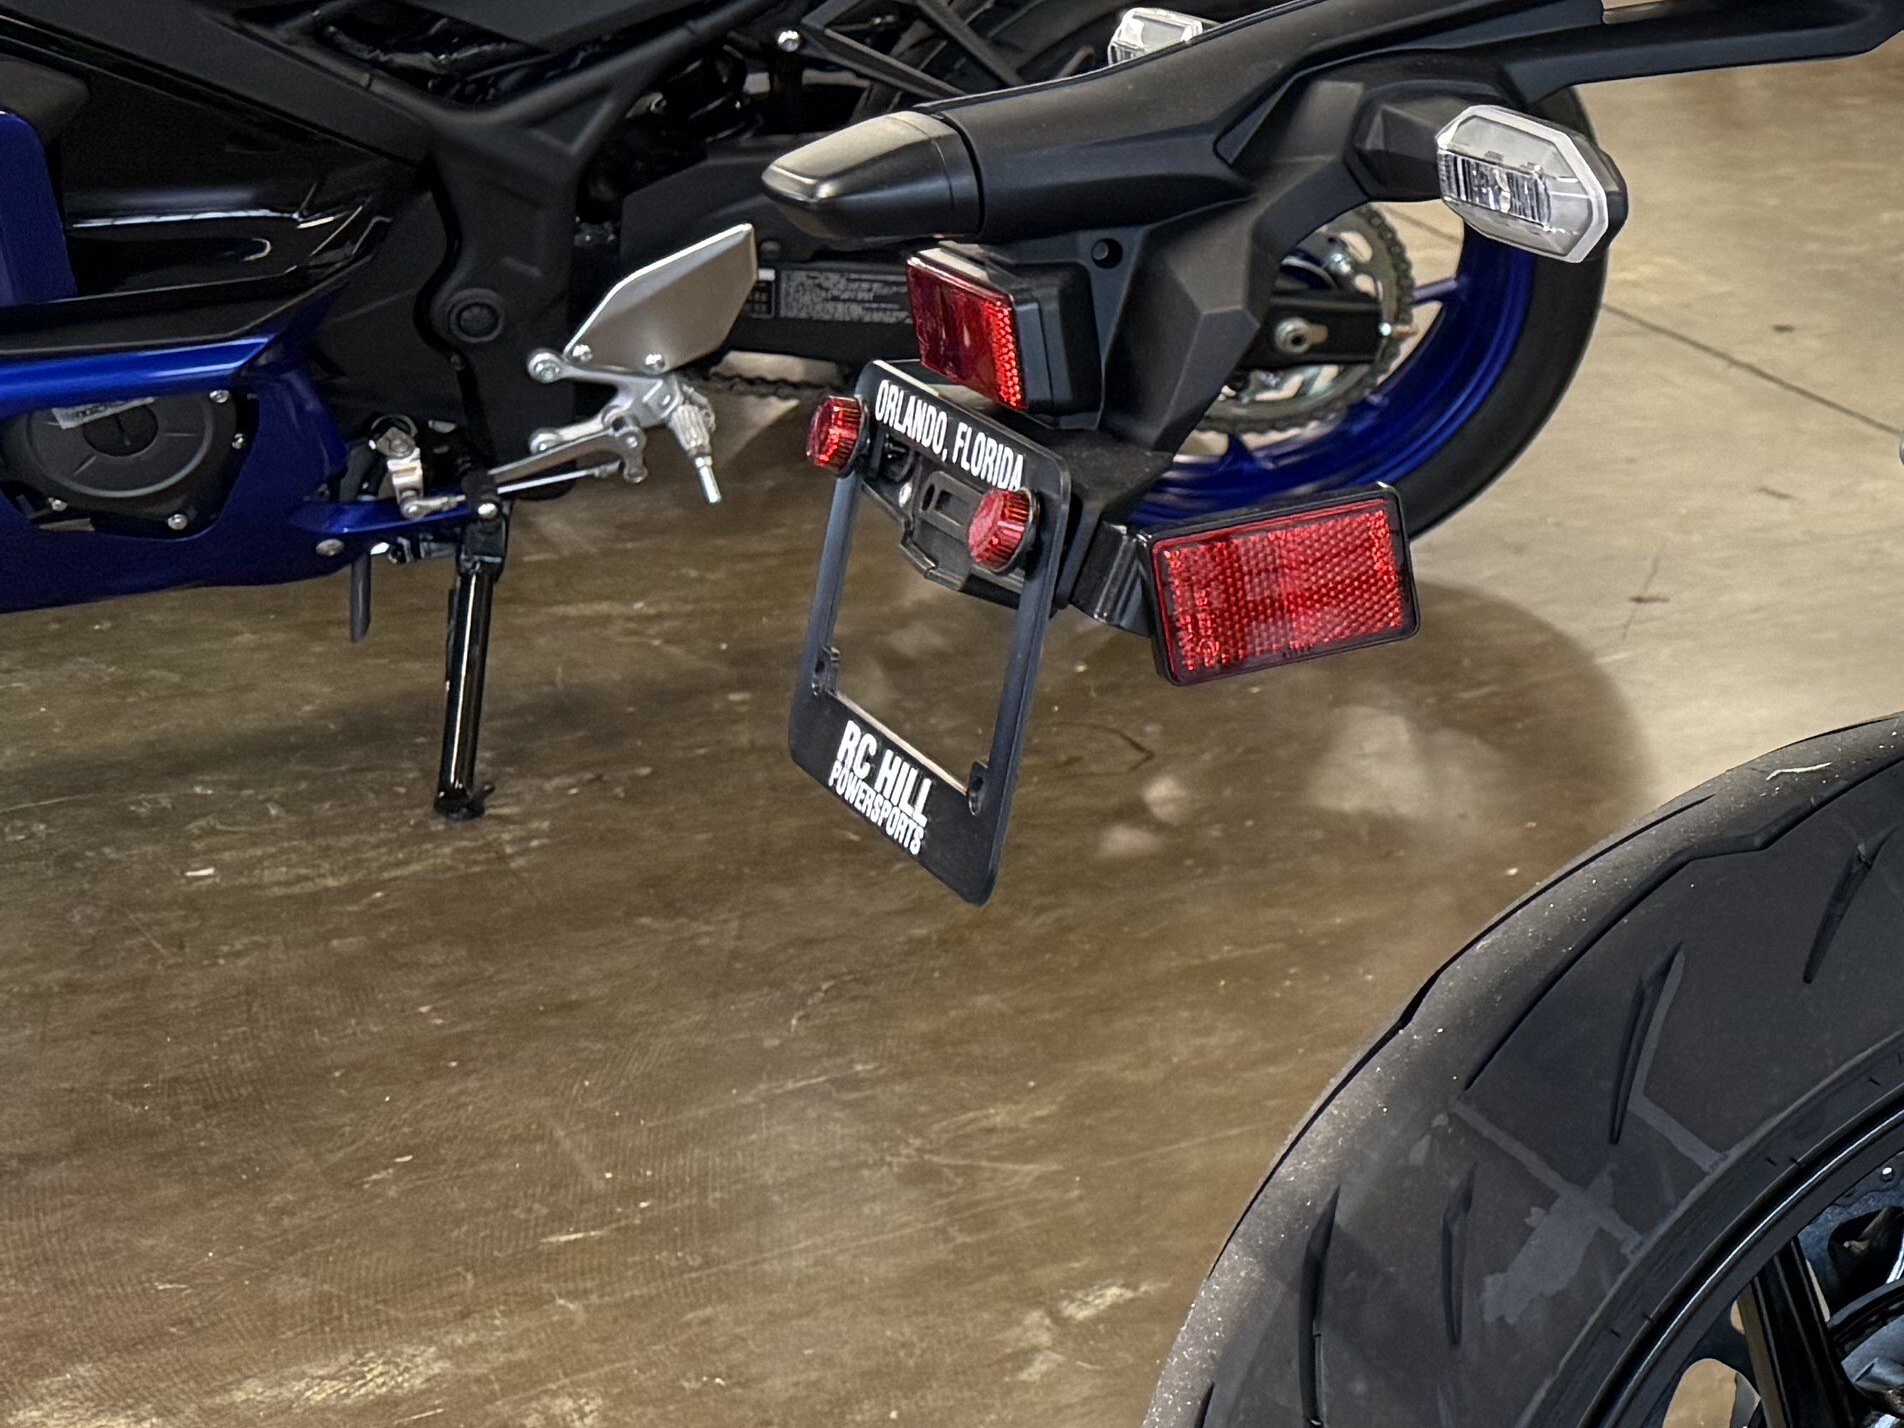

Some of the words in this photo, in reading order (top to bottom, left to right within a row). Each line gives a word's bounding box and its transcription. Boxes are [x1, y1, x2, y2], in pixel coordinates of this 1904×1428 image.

[875, 379, 949, 463] ORLANDO,
[952, 421, 1025, 492] FLORIDA
[828, 759, 926, 856] POWERSPORTS
[836, 719, 878, 780] RC
[873, 748, 932, 828] HILL
